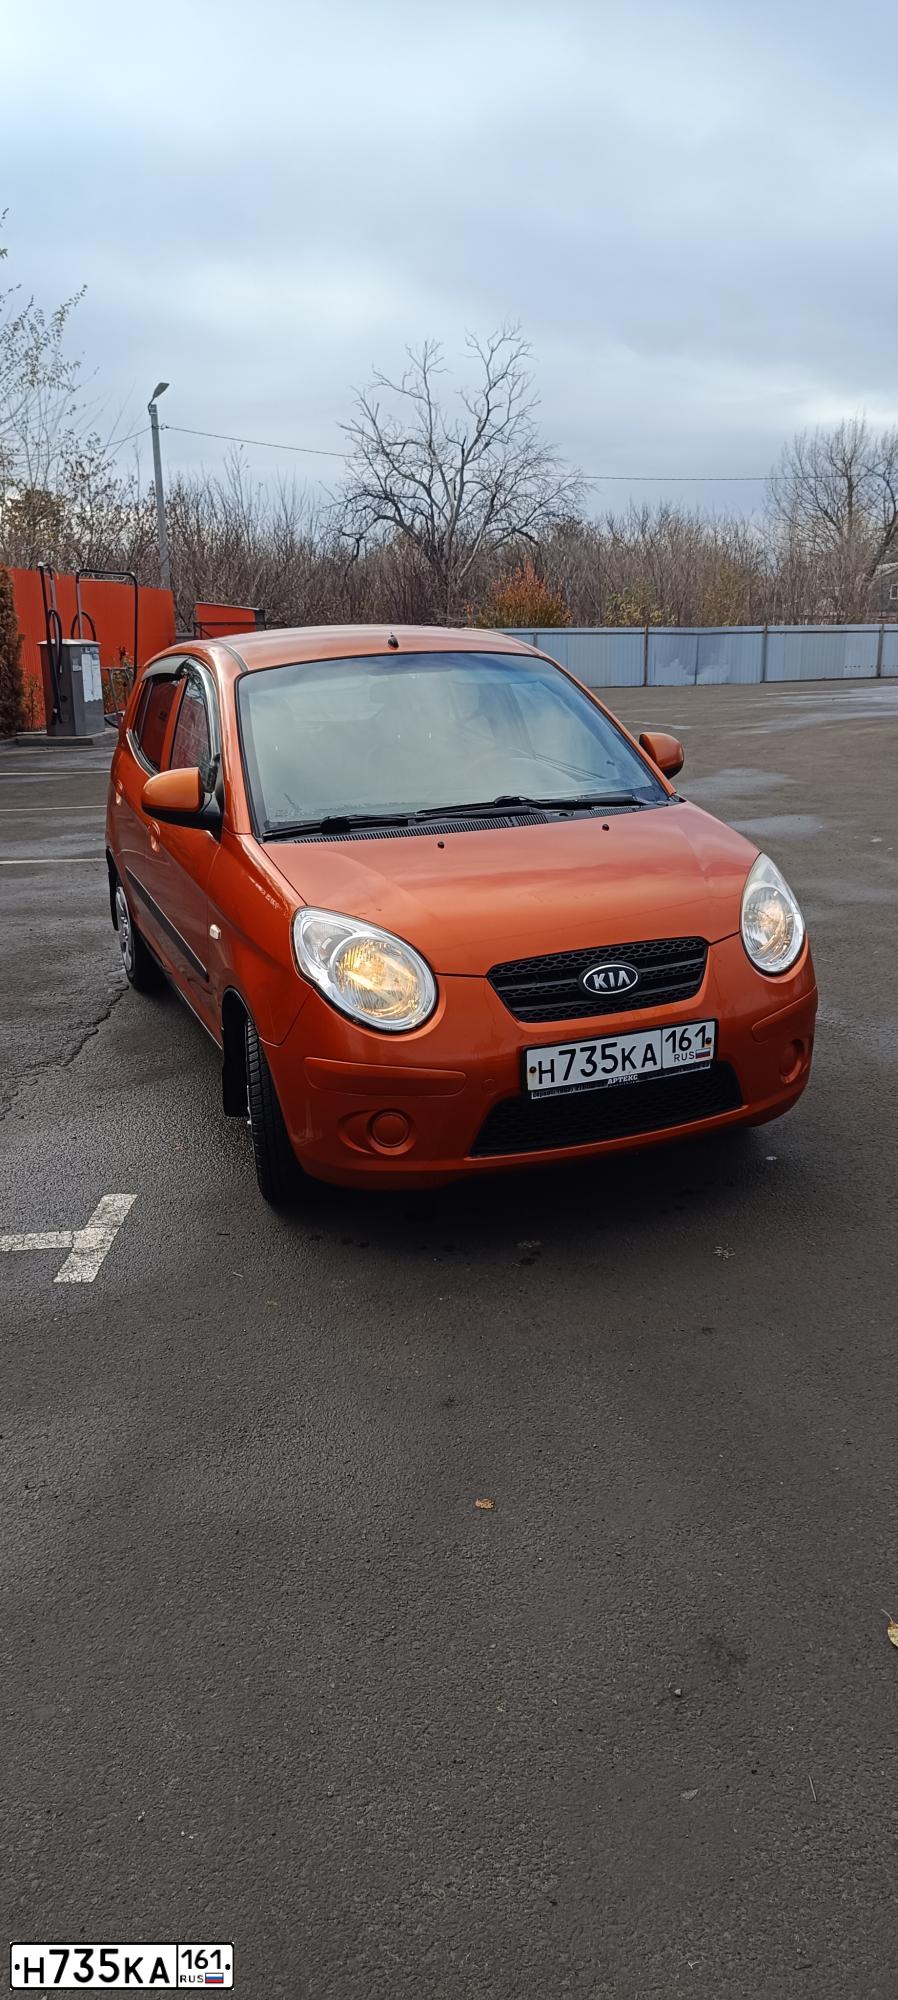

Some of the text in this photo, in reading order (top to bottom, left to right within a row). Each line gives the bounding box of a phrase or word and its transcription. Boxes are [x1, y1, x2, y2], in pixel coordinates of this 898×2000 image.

[593, 970, 630, 989] KIA
[538, 1025, 706, 1084] Н735КА 161
[674, 1051, 694, 1062] RUS
